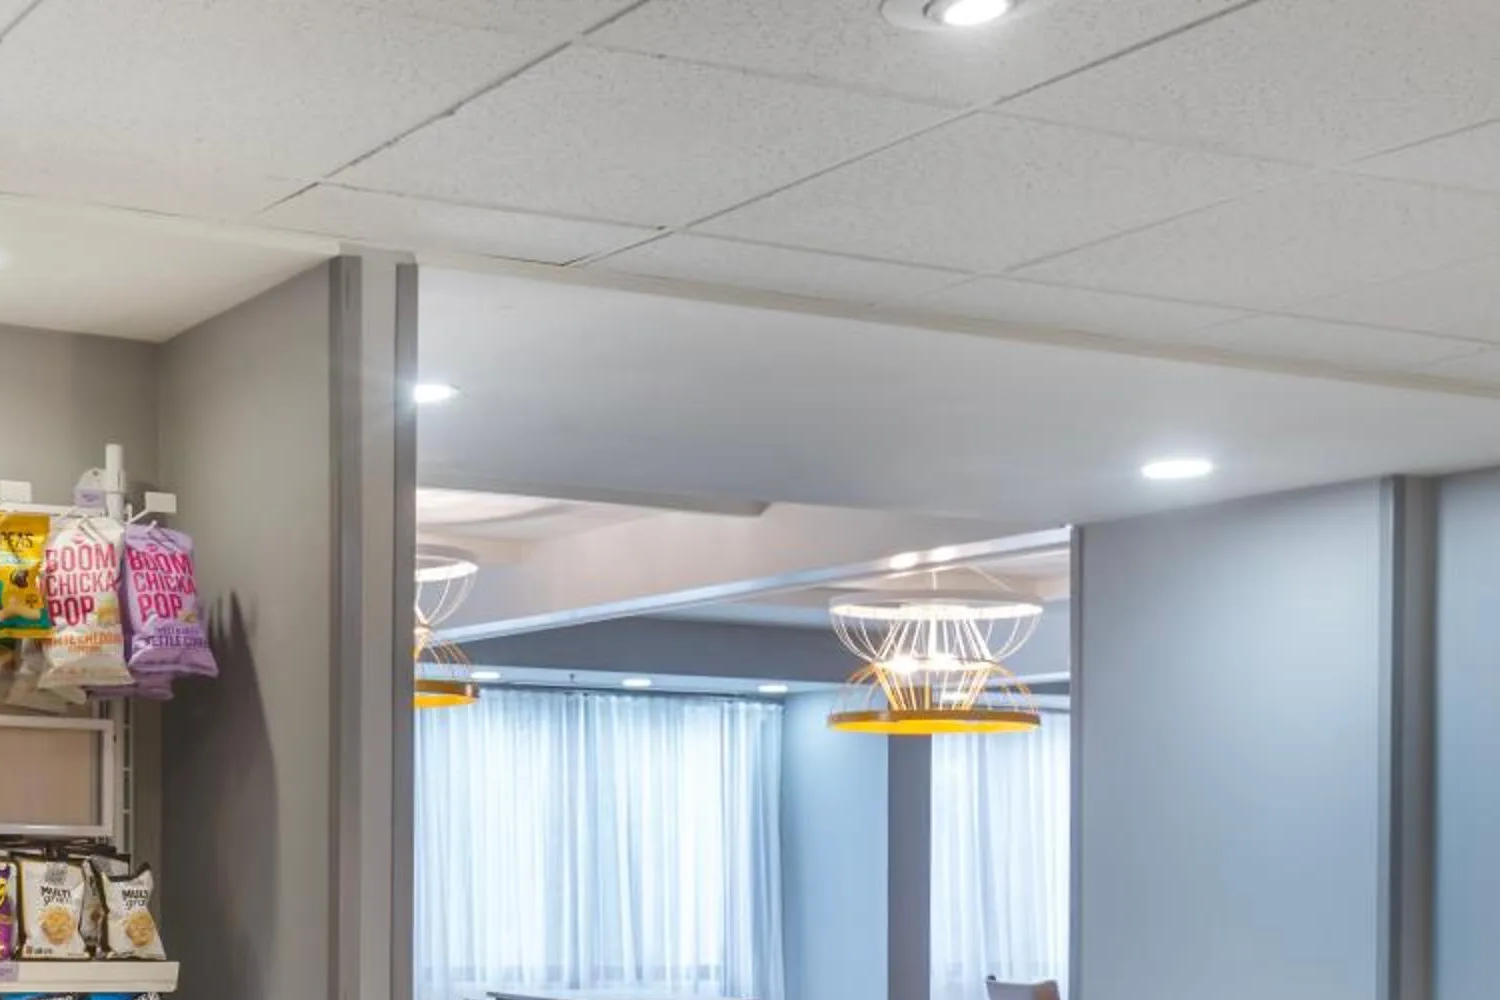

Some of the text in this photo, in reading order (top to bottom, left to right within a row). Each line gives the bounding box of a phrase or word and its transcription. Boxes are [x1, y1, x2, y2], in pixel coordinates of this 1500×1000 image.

[44, 543, 117, 574] BOOM
[126, 545, 194, 576] BOOM
[46, 571, 119, 597] CHICKA
[132, 571, 197, 595] CHICKA
[49, 596, 96, 627] POP
[137, 593, 184, 624] POP
